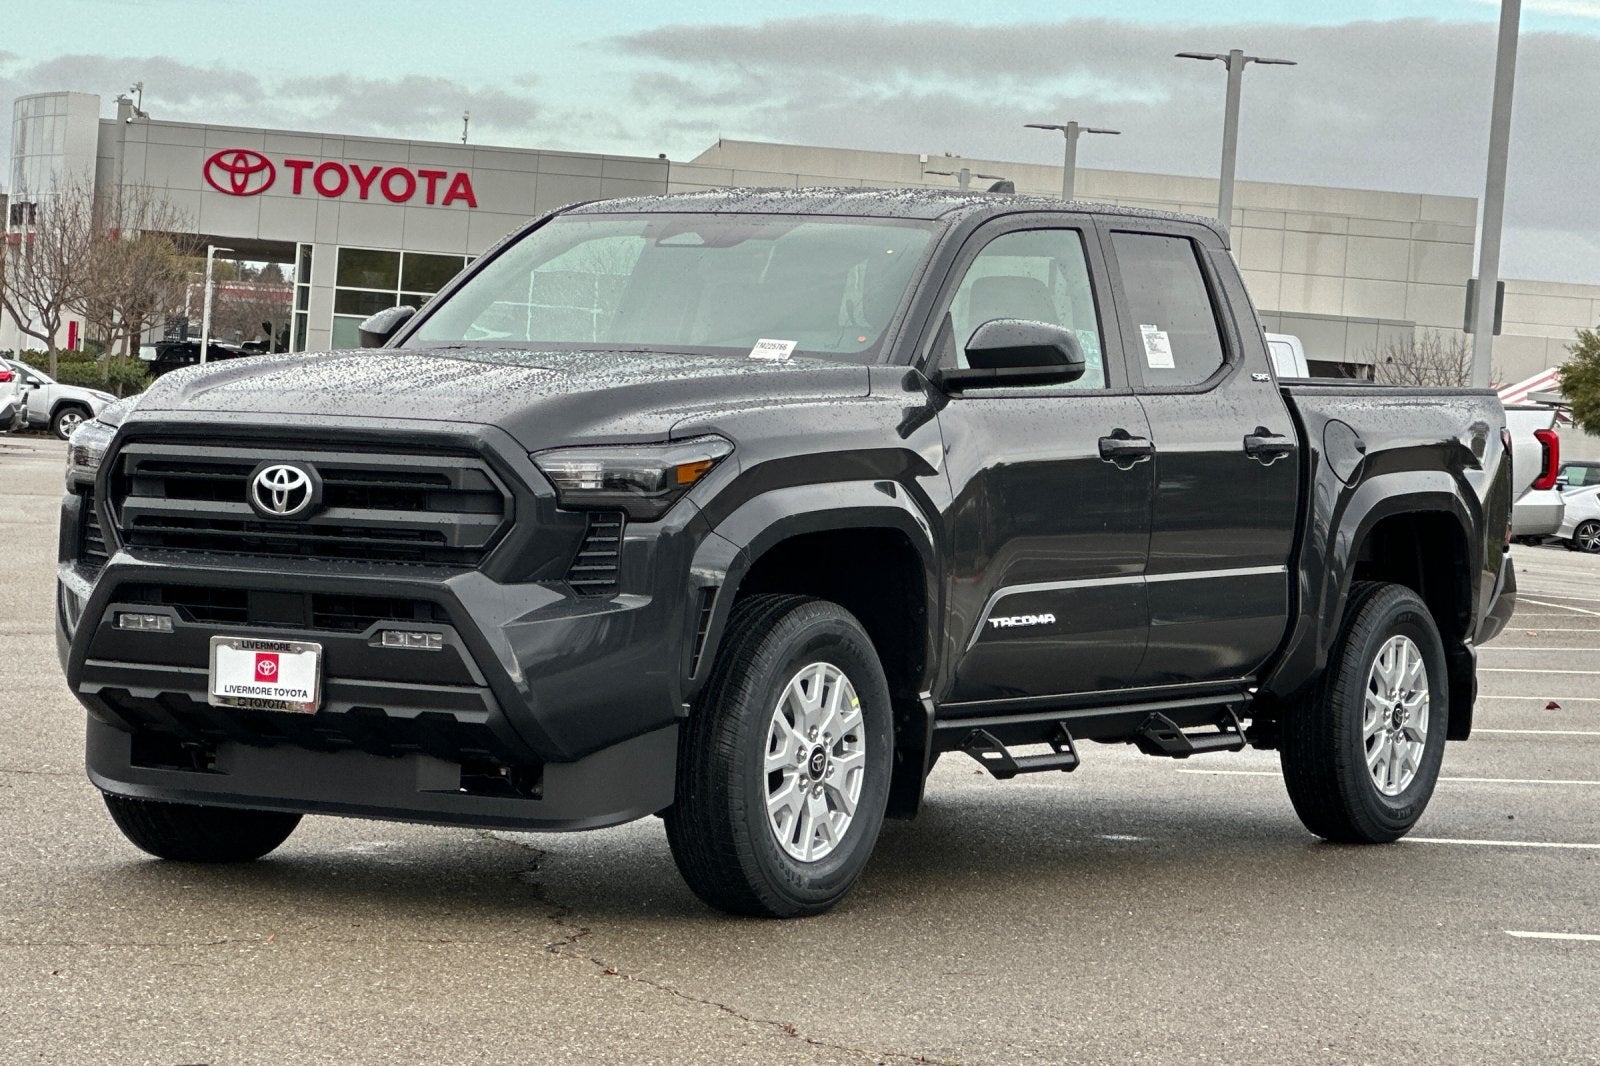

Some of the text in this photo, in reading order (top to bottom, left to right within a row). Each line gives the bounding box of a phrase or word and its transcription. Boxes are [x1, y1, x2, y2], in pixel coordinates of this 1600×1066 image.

[284, 159, 478, 208] TOYOTA
[987, 613, 1057, 629] TACOMA
[241, 640, 292, 652] LIVERMORE
[224, 684, 308, 699] LIVERMORE TOYOTA
[248, 698, 287, 710] TOYOTA
